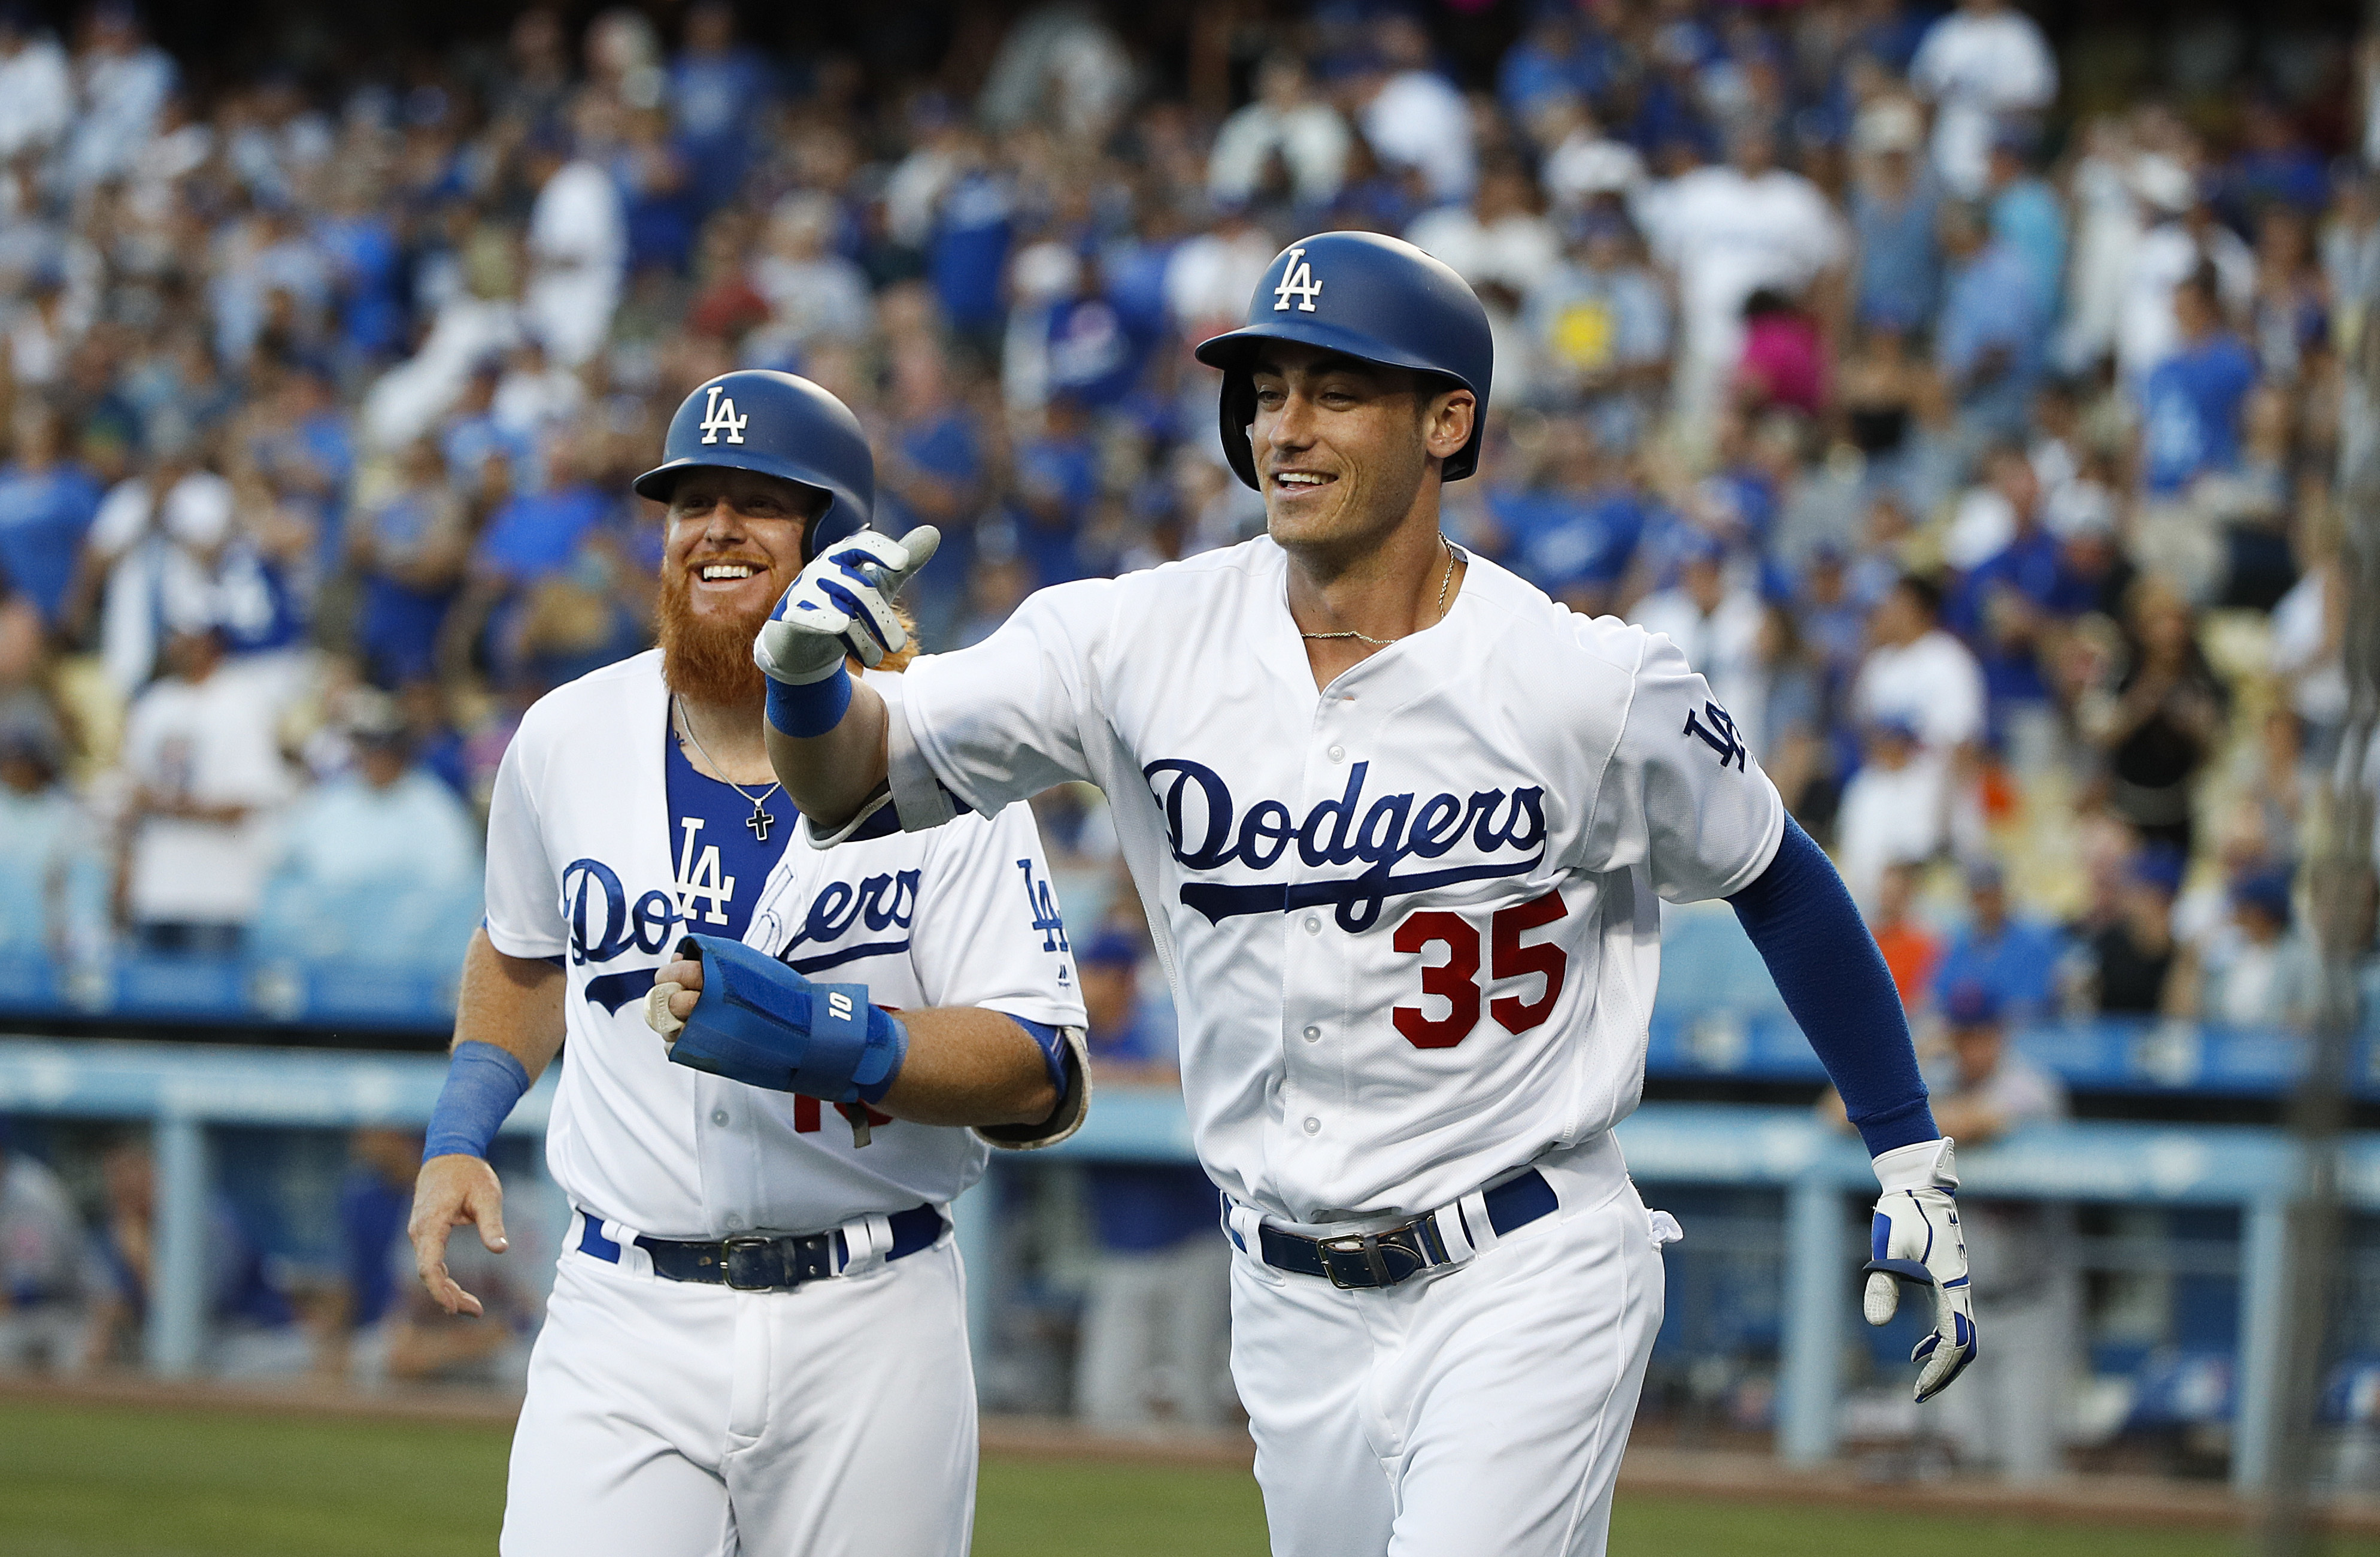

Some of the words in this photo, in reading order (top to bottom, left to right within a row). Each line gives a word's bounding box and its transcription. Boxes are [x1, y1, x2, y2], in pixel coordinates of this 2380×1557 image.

[1274, 249, 1323, 313] LA
[699, 386, 748, 444] LA
[675, 816, 735, 926] LA
[1143, 758, 1548, 934] Dodgers
[1016, 859, 1068, 952] LA
[829, 991, 853, 1022] 10
[1393, 888, 1568, 1049] 35
